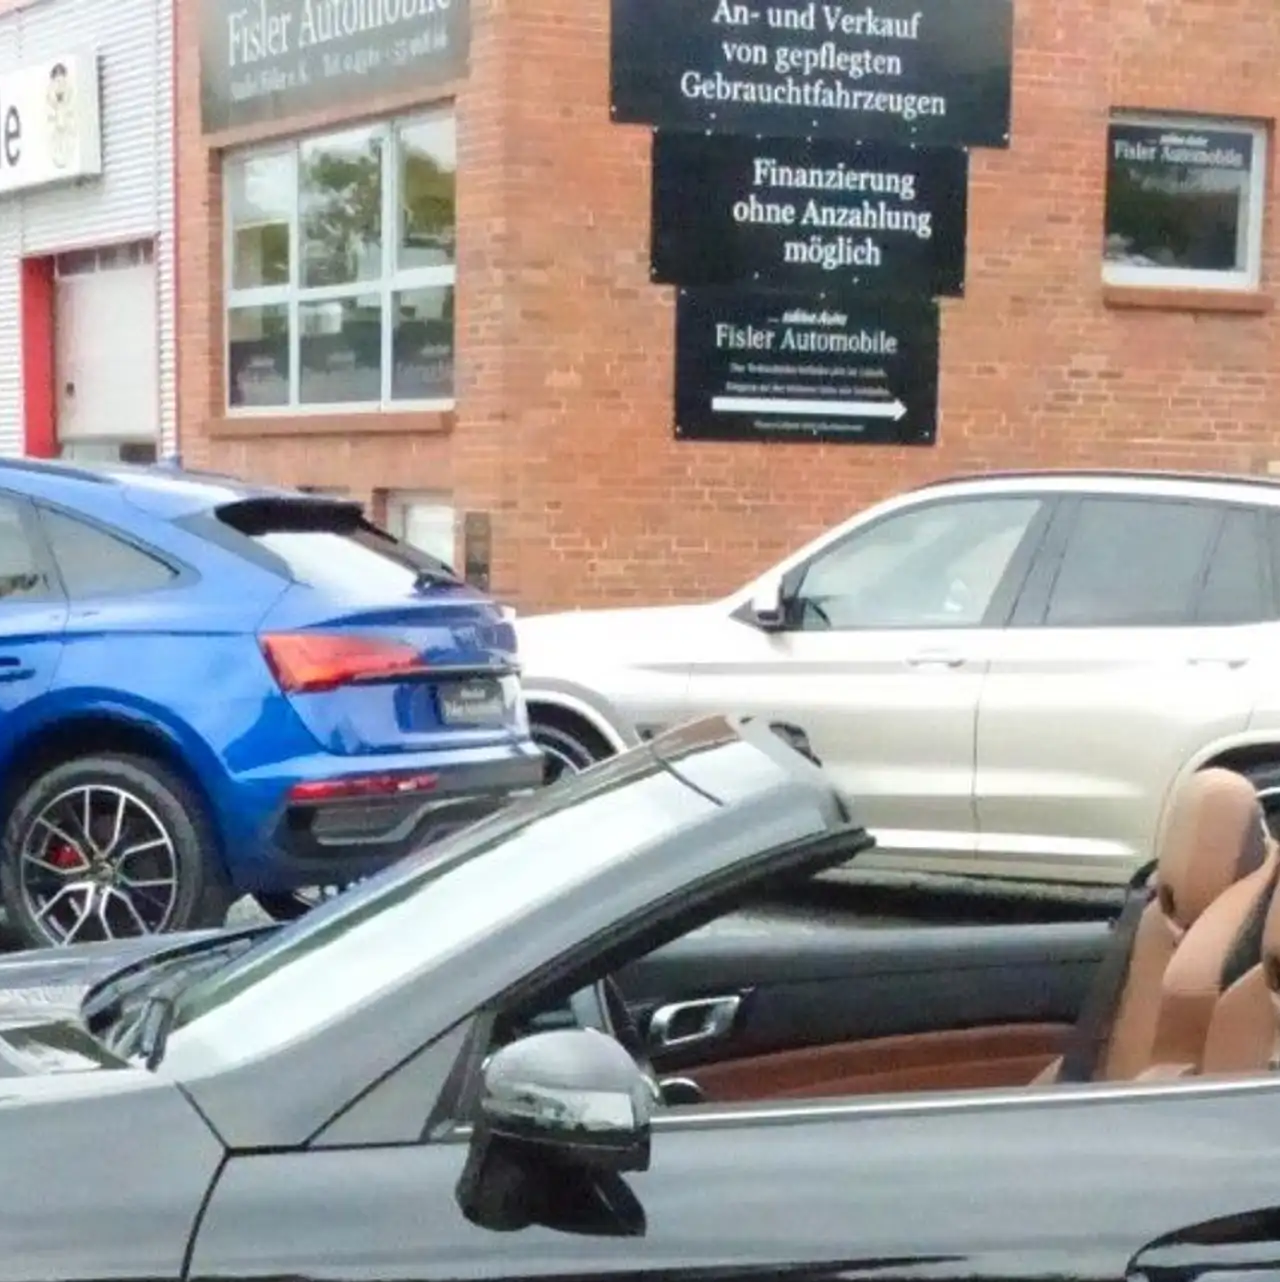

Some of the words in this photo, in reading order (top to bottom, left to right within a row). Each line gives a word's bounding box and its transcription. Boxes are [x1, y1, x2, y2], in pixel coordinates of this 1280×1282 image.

[228, 0, 291, 67] Fisler
[711, 1, 760, 26] An-
[767, 3, 816, 30] und
[821, 5, 922, 39] Verkauf
[722, 41, 768, 65] von
[774, 41, 902, 78] gepflegten
[680, 71, 946, 120] Gebrauchtfahrzeugen
[752, 158, 916, 200] Finanzierung
[733, 194, 795, 225] ohne
[800, 198, 932, 239] Anzahlung
[783, 235, 881, 270] möglich
[715, 323, 776, 349] Fisler
[780, 327, 898, 354] Automobile
